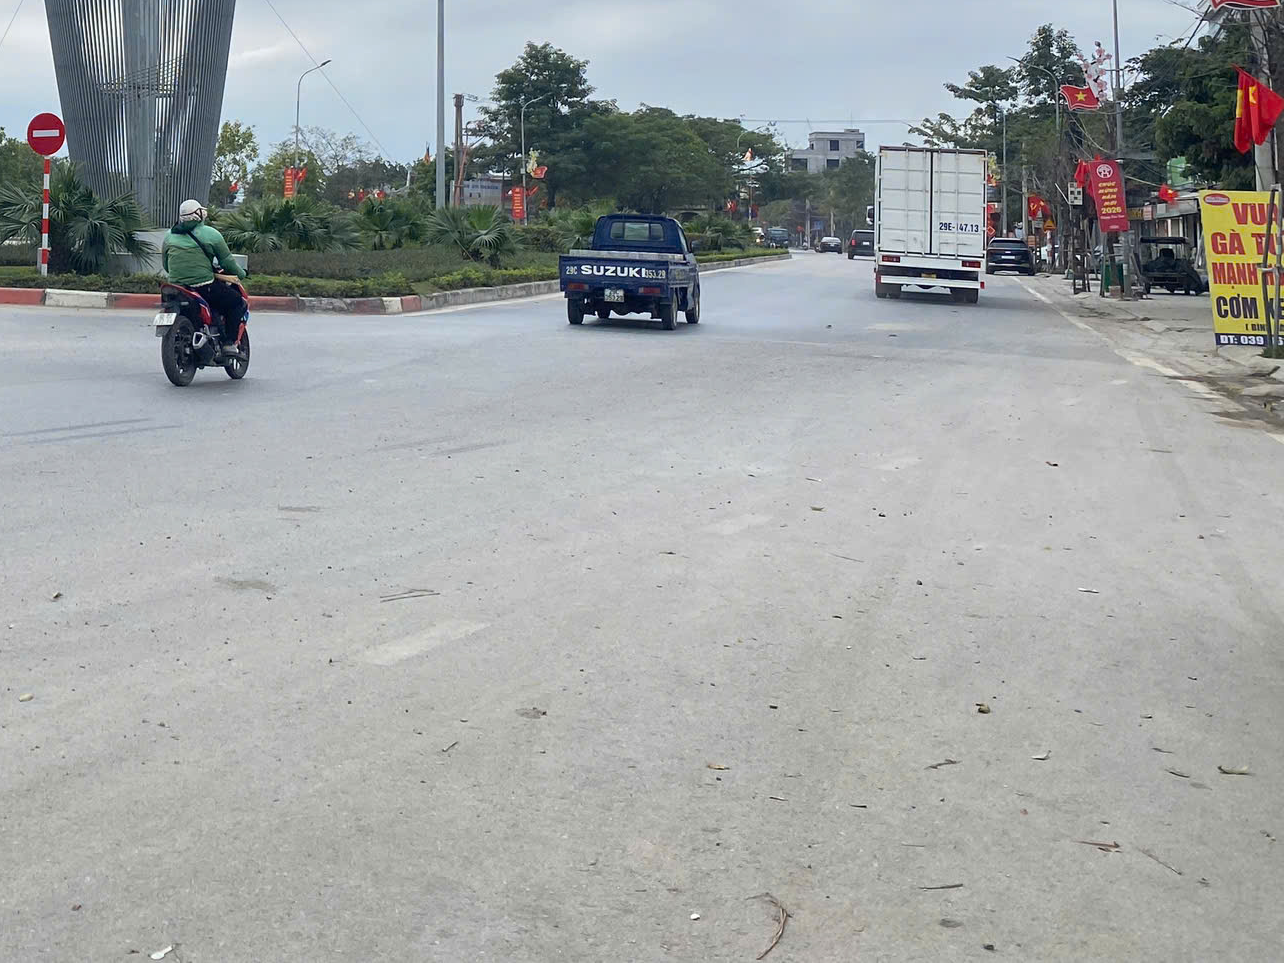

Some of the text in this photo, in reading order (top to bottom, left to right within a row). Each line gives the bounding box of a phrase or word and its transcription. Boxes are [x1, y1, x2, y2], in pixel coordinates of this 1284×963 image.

[1211, 229, 1246, 255] GÀ
[581, 265, 646, 278] SUZUKI
[1211, 262, 1259, 290] MẠNH
[1216, 293, 1259, 319] CƠM
